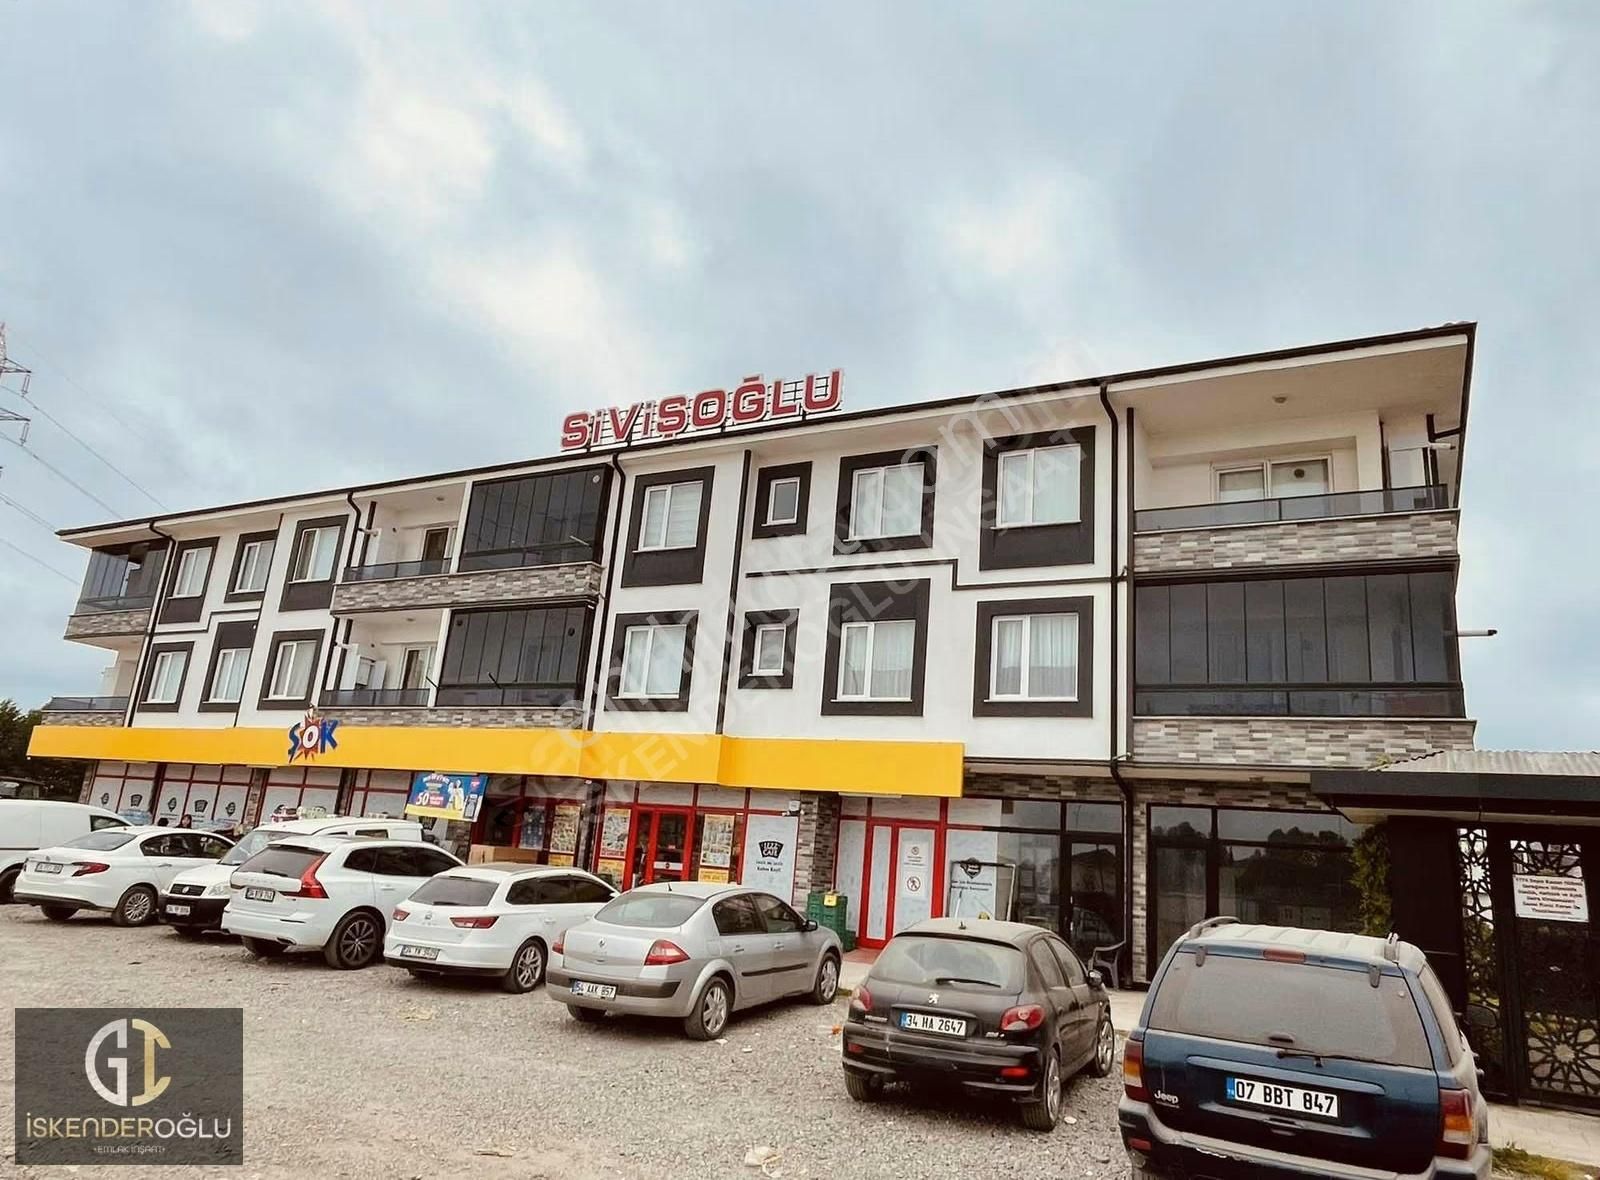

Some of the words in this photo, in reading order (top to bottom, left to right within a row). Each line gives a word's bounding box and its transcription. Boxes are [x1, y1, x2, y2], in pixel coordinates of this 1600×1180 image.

[906, 1014, 918, 1024] 34
[922, 1017, 935, 1030] HA
[938, 1019, 964, 1034] 2647
[1154, 1089, 1179, 1104] Jeep
[1235, 1080, 1255, 1099] 07
[1263, 1086, 1294, 1107] BBT
[1303, 1092, 1335, 1114] 847
